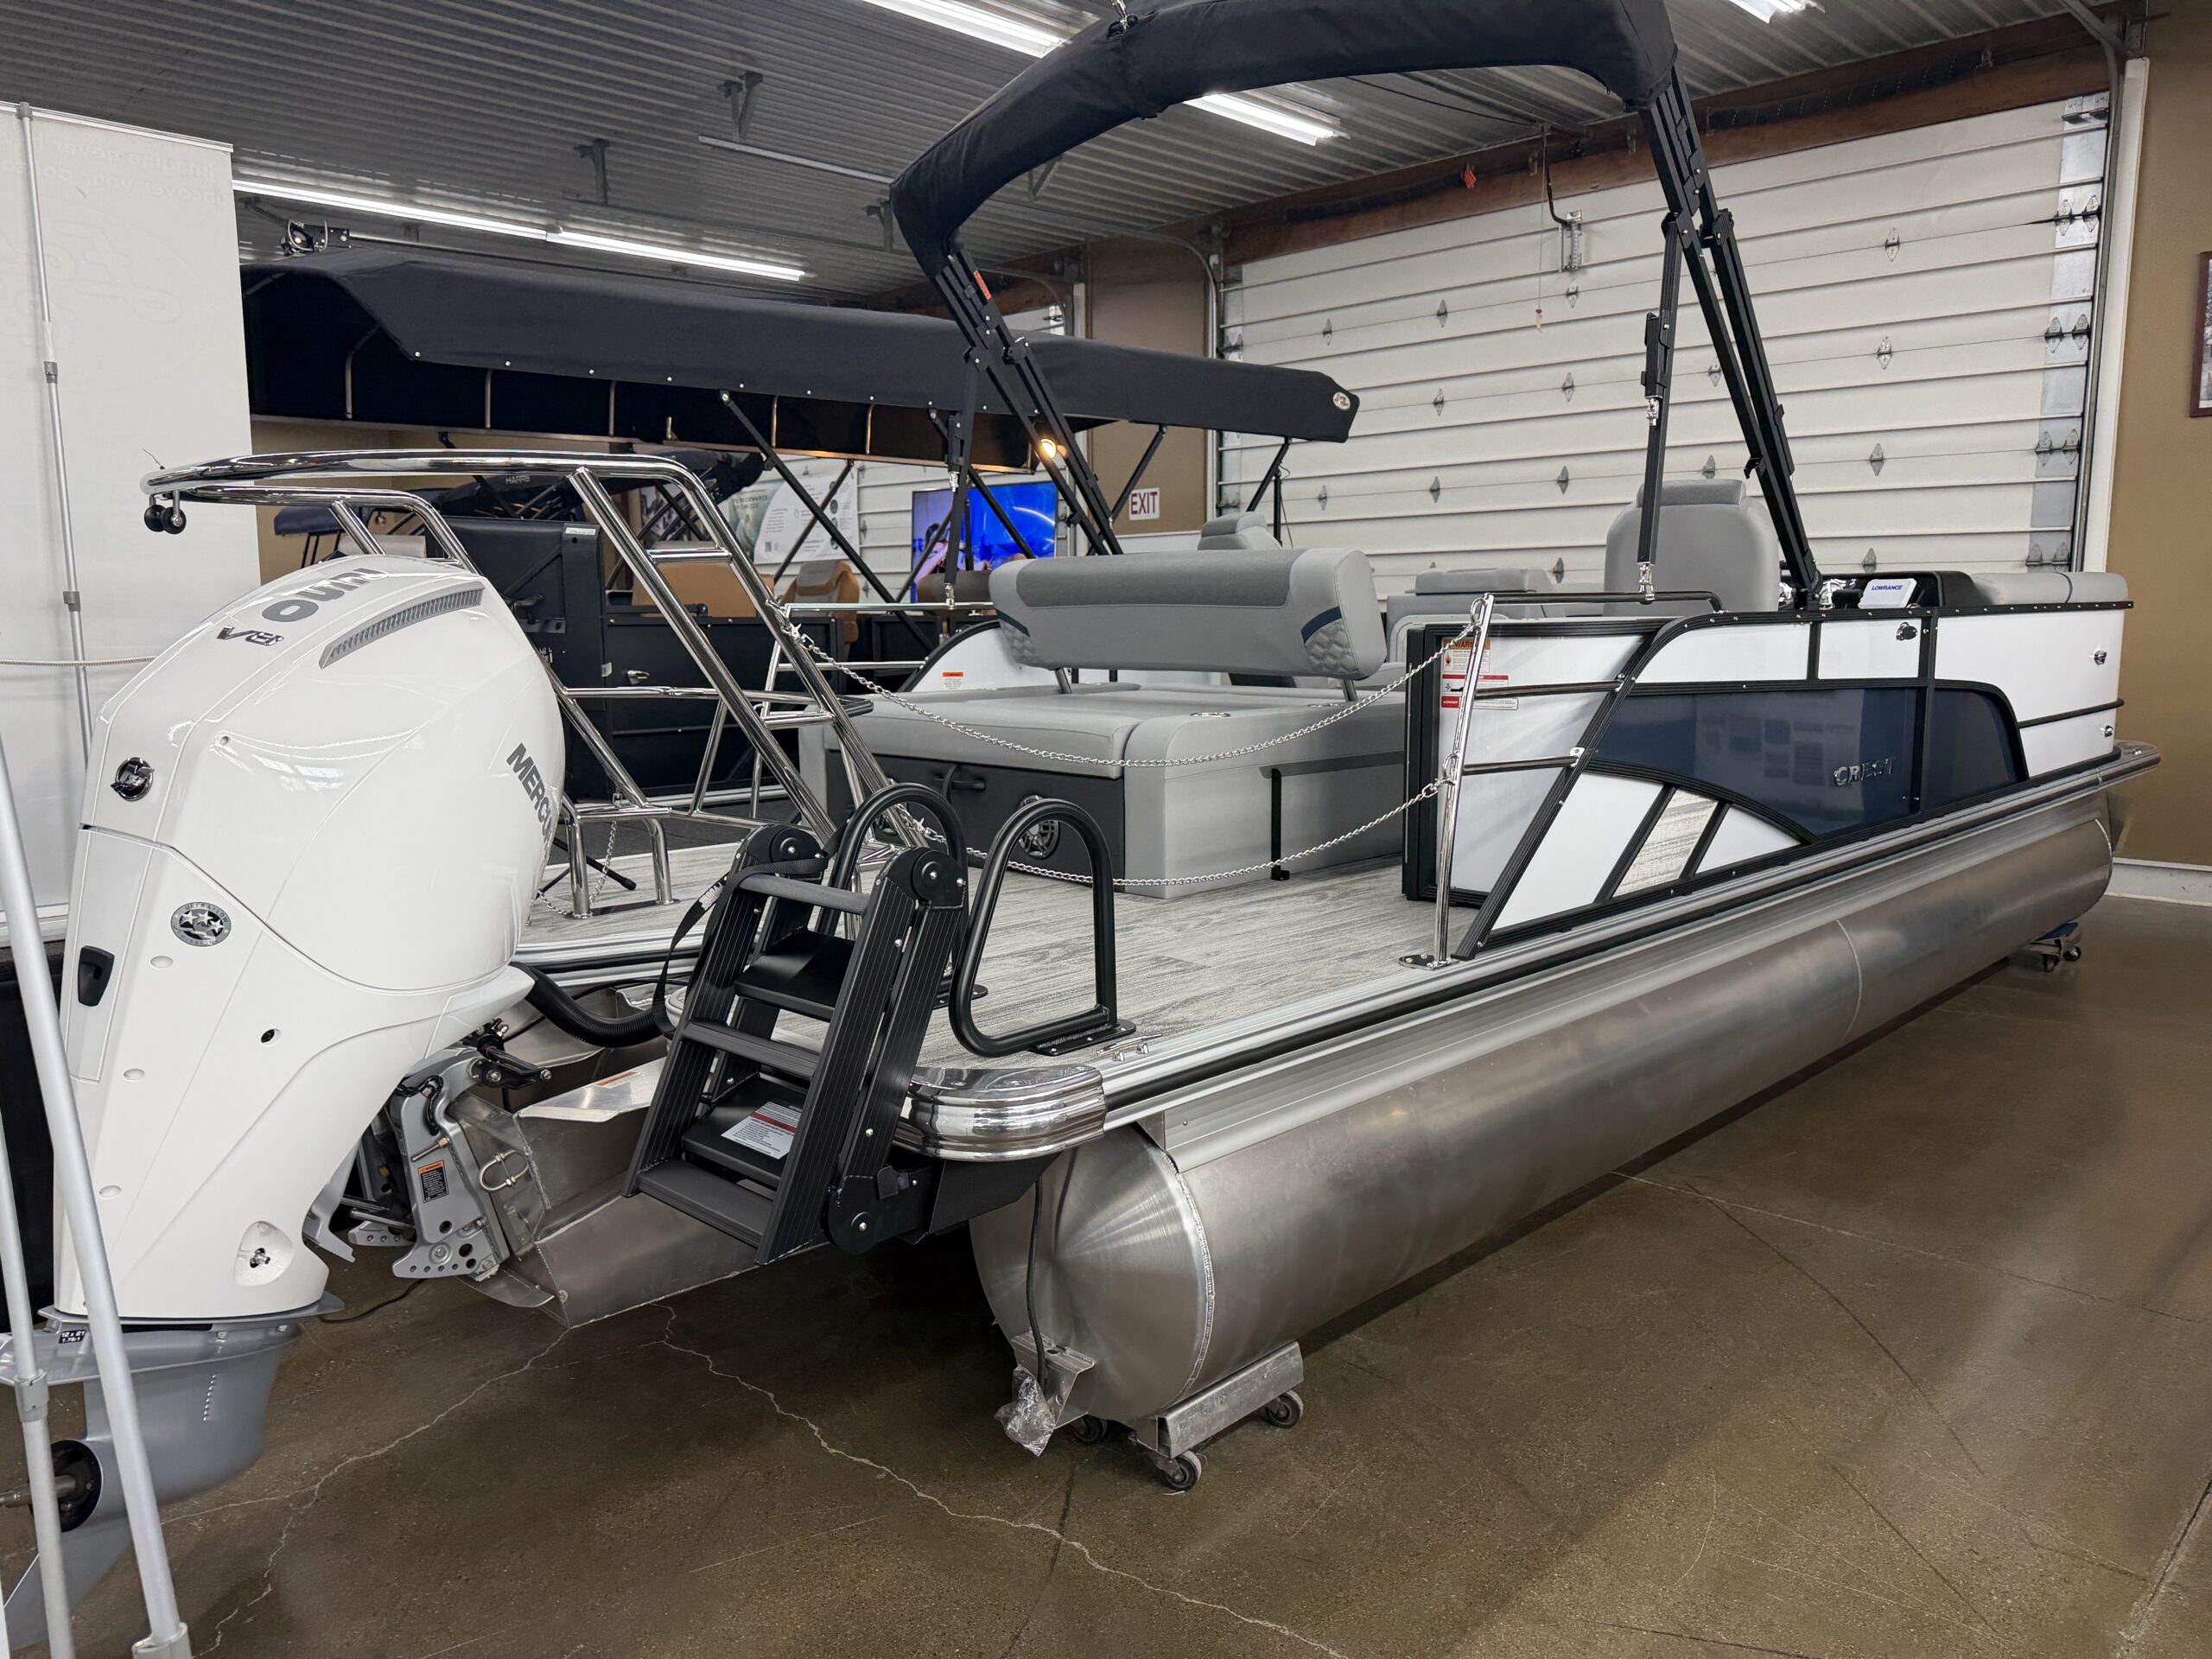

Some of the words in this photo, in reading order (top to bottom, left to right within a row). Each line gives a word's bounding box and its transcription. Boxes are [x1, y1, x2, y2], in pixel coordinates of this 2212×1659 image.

[1131, 492, 1158, 514] EXIT
[217, 625, 284, 646] V8
[1833, 757, 1895, 786] CREST
